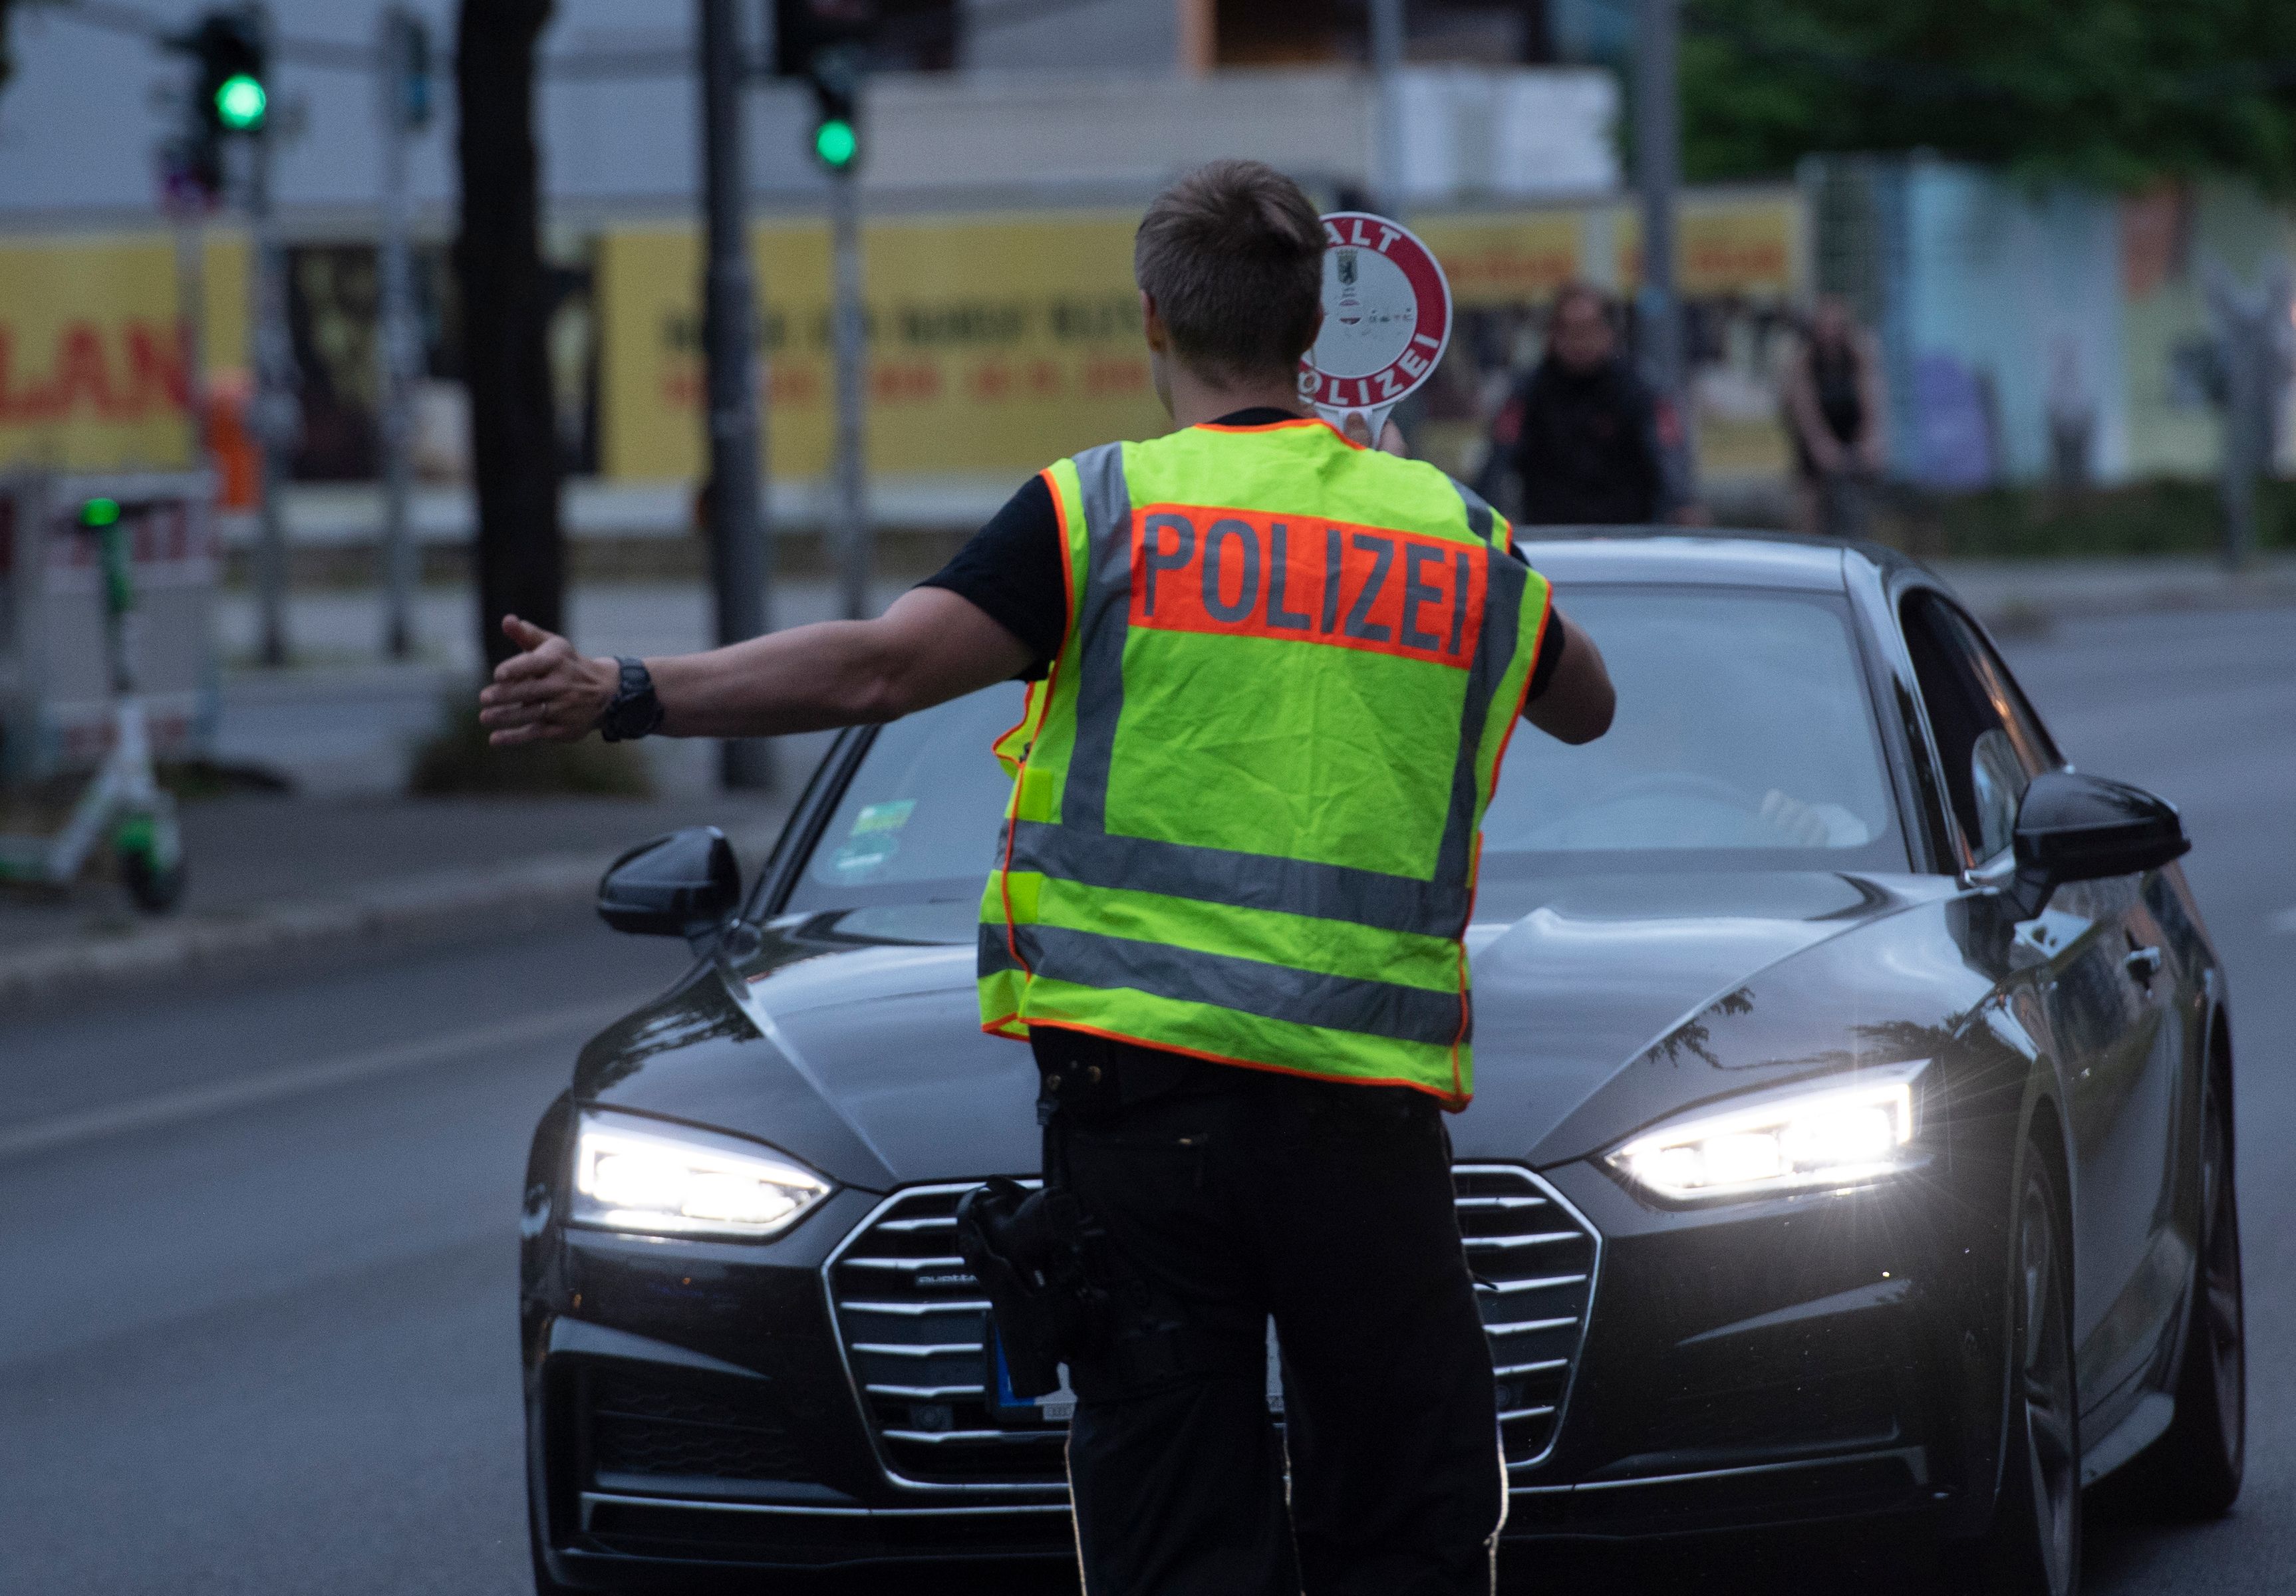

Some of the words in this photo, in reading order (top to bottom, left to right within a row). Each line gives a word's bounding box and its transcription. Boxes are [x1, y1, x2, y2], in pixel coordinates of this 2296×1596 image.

[1325, 219, 1401, 253] ALT
[1298, 334, 1439, 404] OLIZEI
[1143, 513, 1469, 655] POLIZEI
[918, 1274, 976, 1285] quattr
